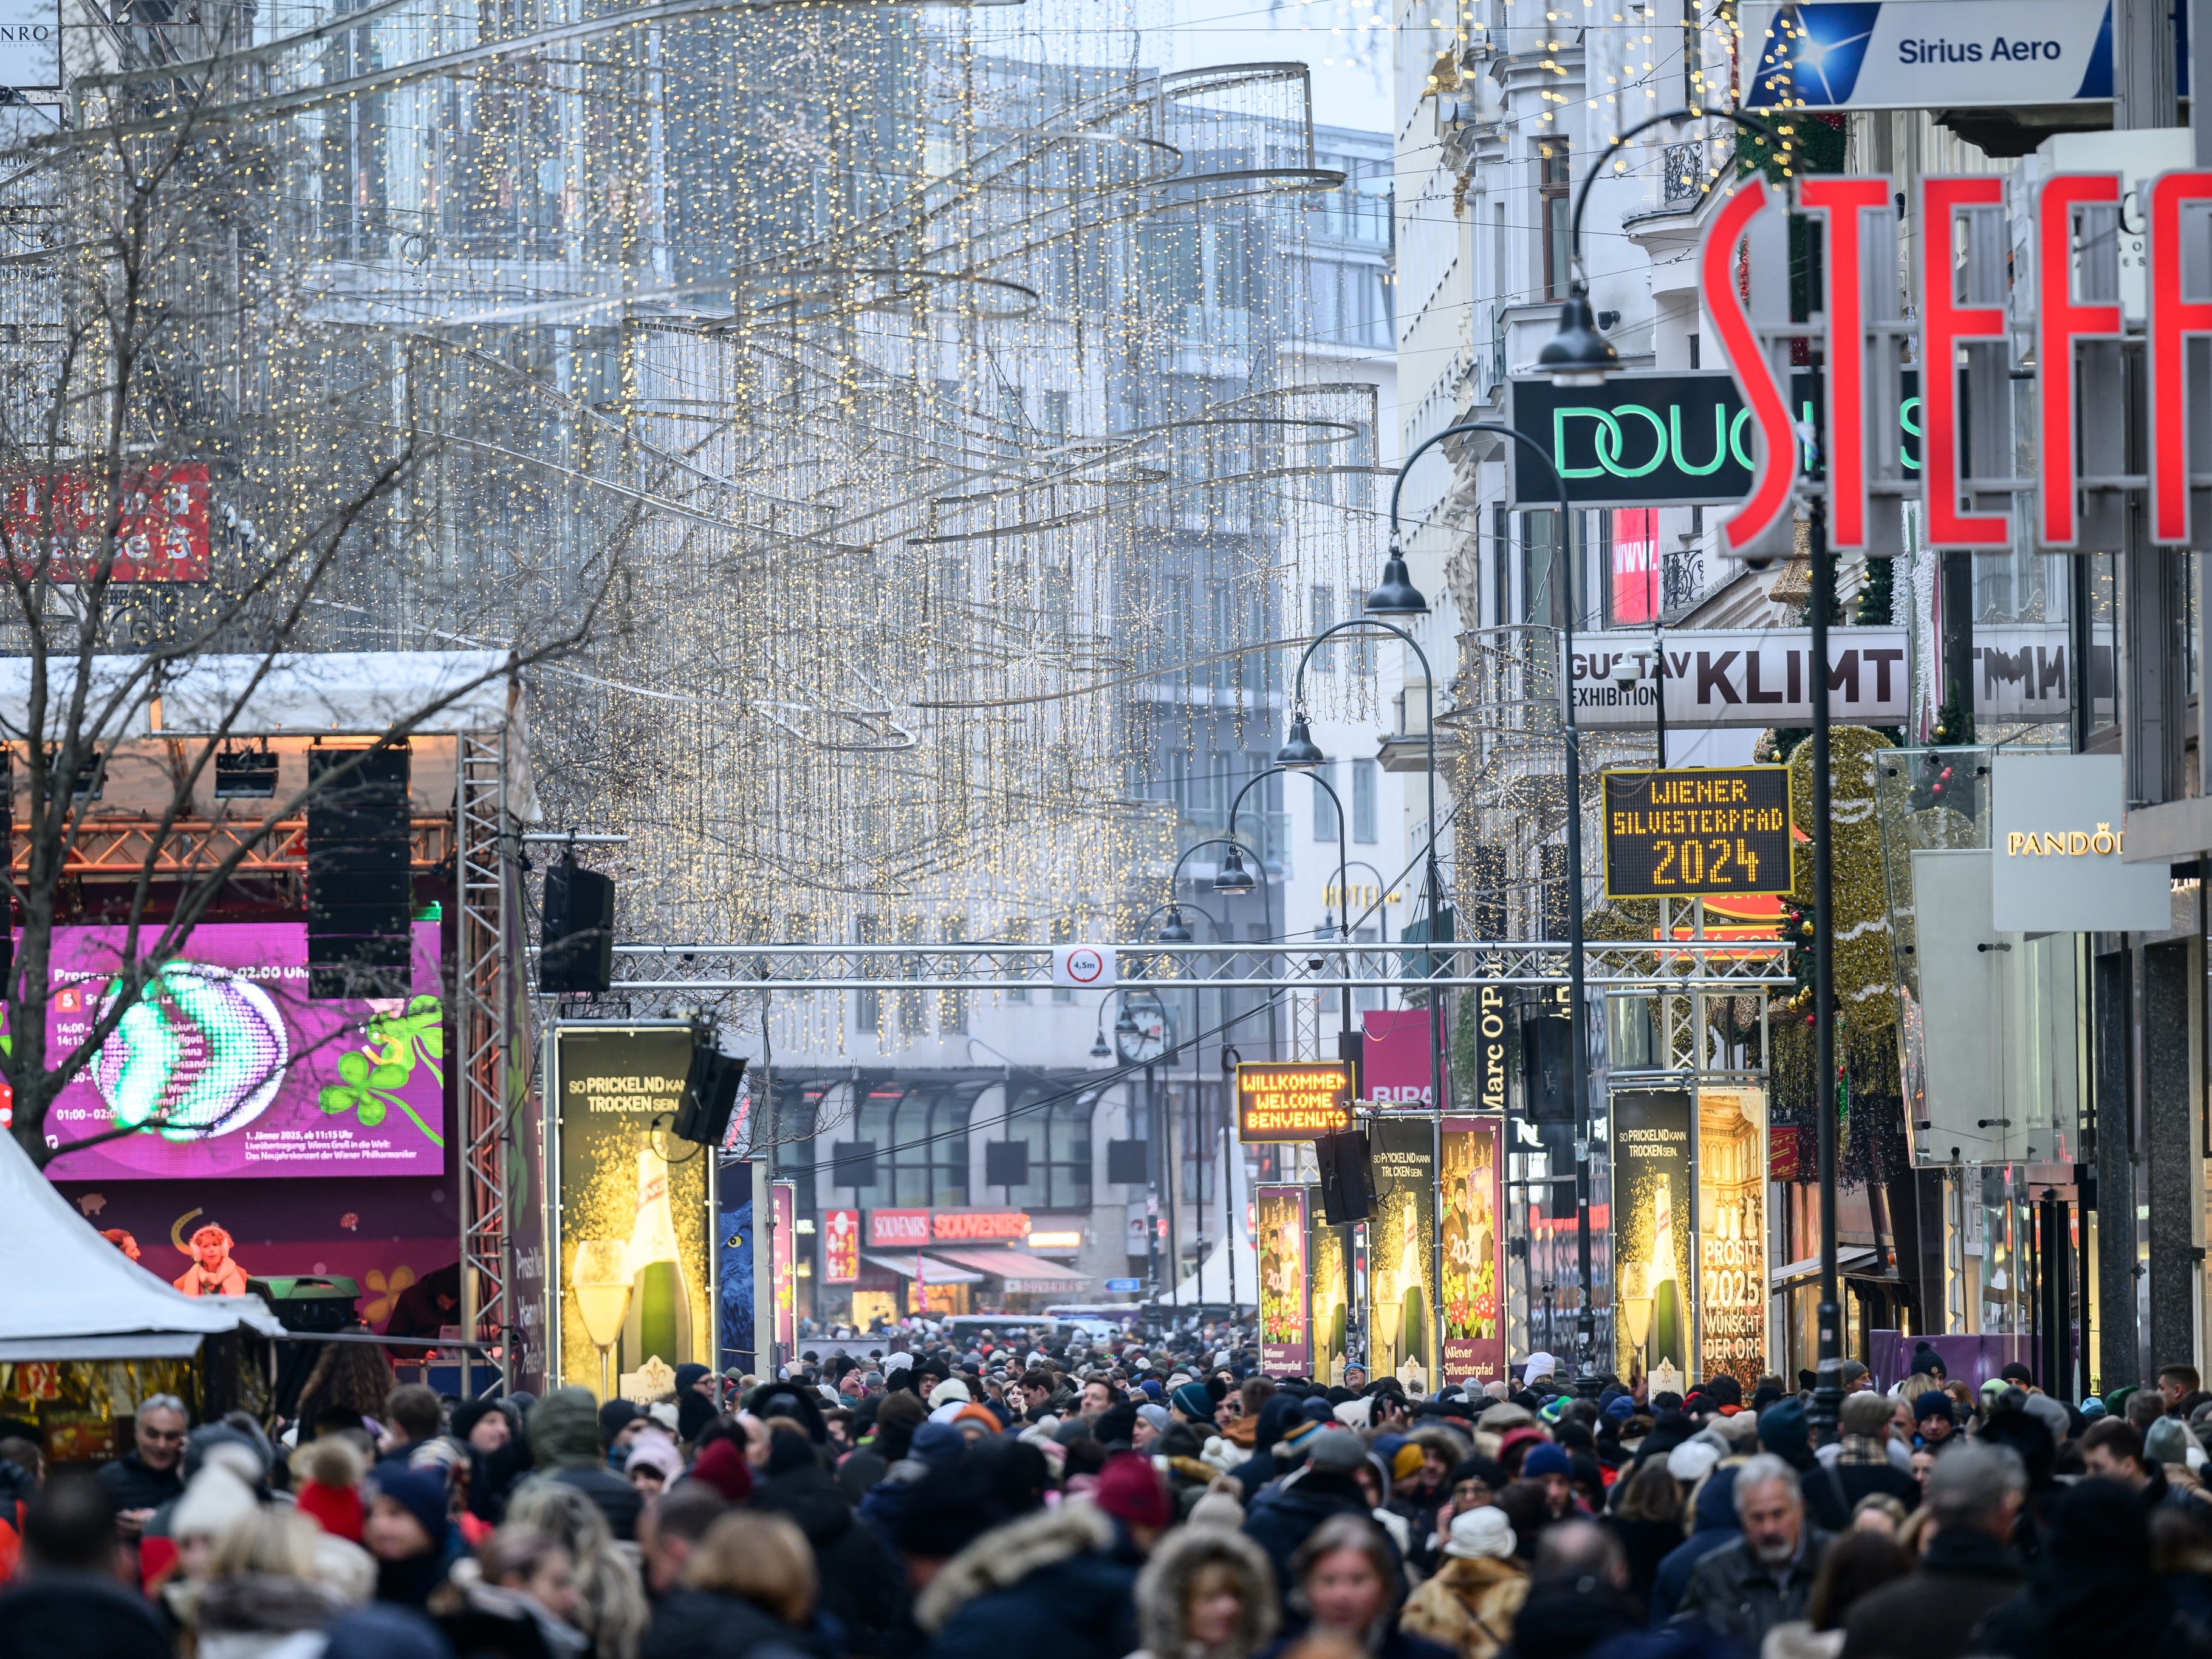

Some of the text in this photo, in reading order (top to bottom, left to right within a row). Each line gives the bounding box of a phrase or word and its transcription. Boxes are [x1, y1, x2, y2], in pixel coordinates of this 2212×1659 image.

[1899, 36, 2061, 64] Sirius Aero
[165, 527, 191, 559] 5
[1696, 649, 1904, 705] KLIMT
[1651, 779, 1747, 804] WIENER
[1613, 807, 1783, 835] SILVESTERPFAD
[1652, 838, 1759, 885] 2024
[569, 1080, 586, 1094] SO
[586, 1076, 665, 1093] PRICKELND
[587, 1095, 652, 1112] TROCKEN
[1255, 1092, 1333, 1109] WELCOME
[1247, 1112, 1347, 1129] BENVENUTO
[1618, 1129, 1686, 1142] SO PRICKELND KANN
[1373, 1155, 1382, 1164] SO
[1416, 1155, 1431, 1163] KANN
[1629, 1144, 1678, 1158] TROCKEN SEIN.
[933, 1214, 1024, 1239] SOUVENIRS
[1704, 1240, 1759, 1266] PROSIT
[1706, 1270, 1760, 1308] 2025
[1705, 1311, 1761, 1335] WÜNSCHT
[1264, 1348, 1285, 1358] Wiener
[1445, 1346, 1473, 1359] Wiener
[1705, 1338, 1761, 1360] DER ORF
[1264, 1360, 1302, 1374] Silvesterpfad
[1445, 1362, 1495, 1379] Silvesterpfad
